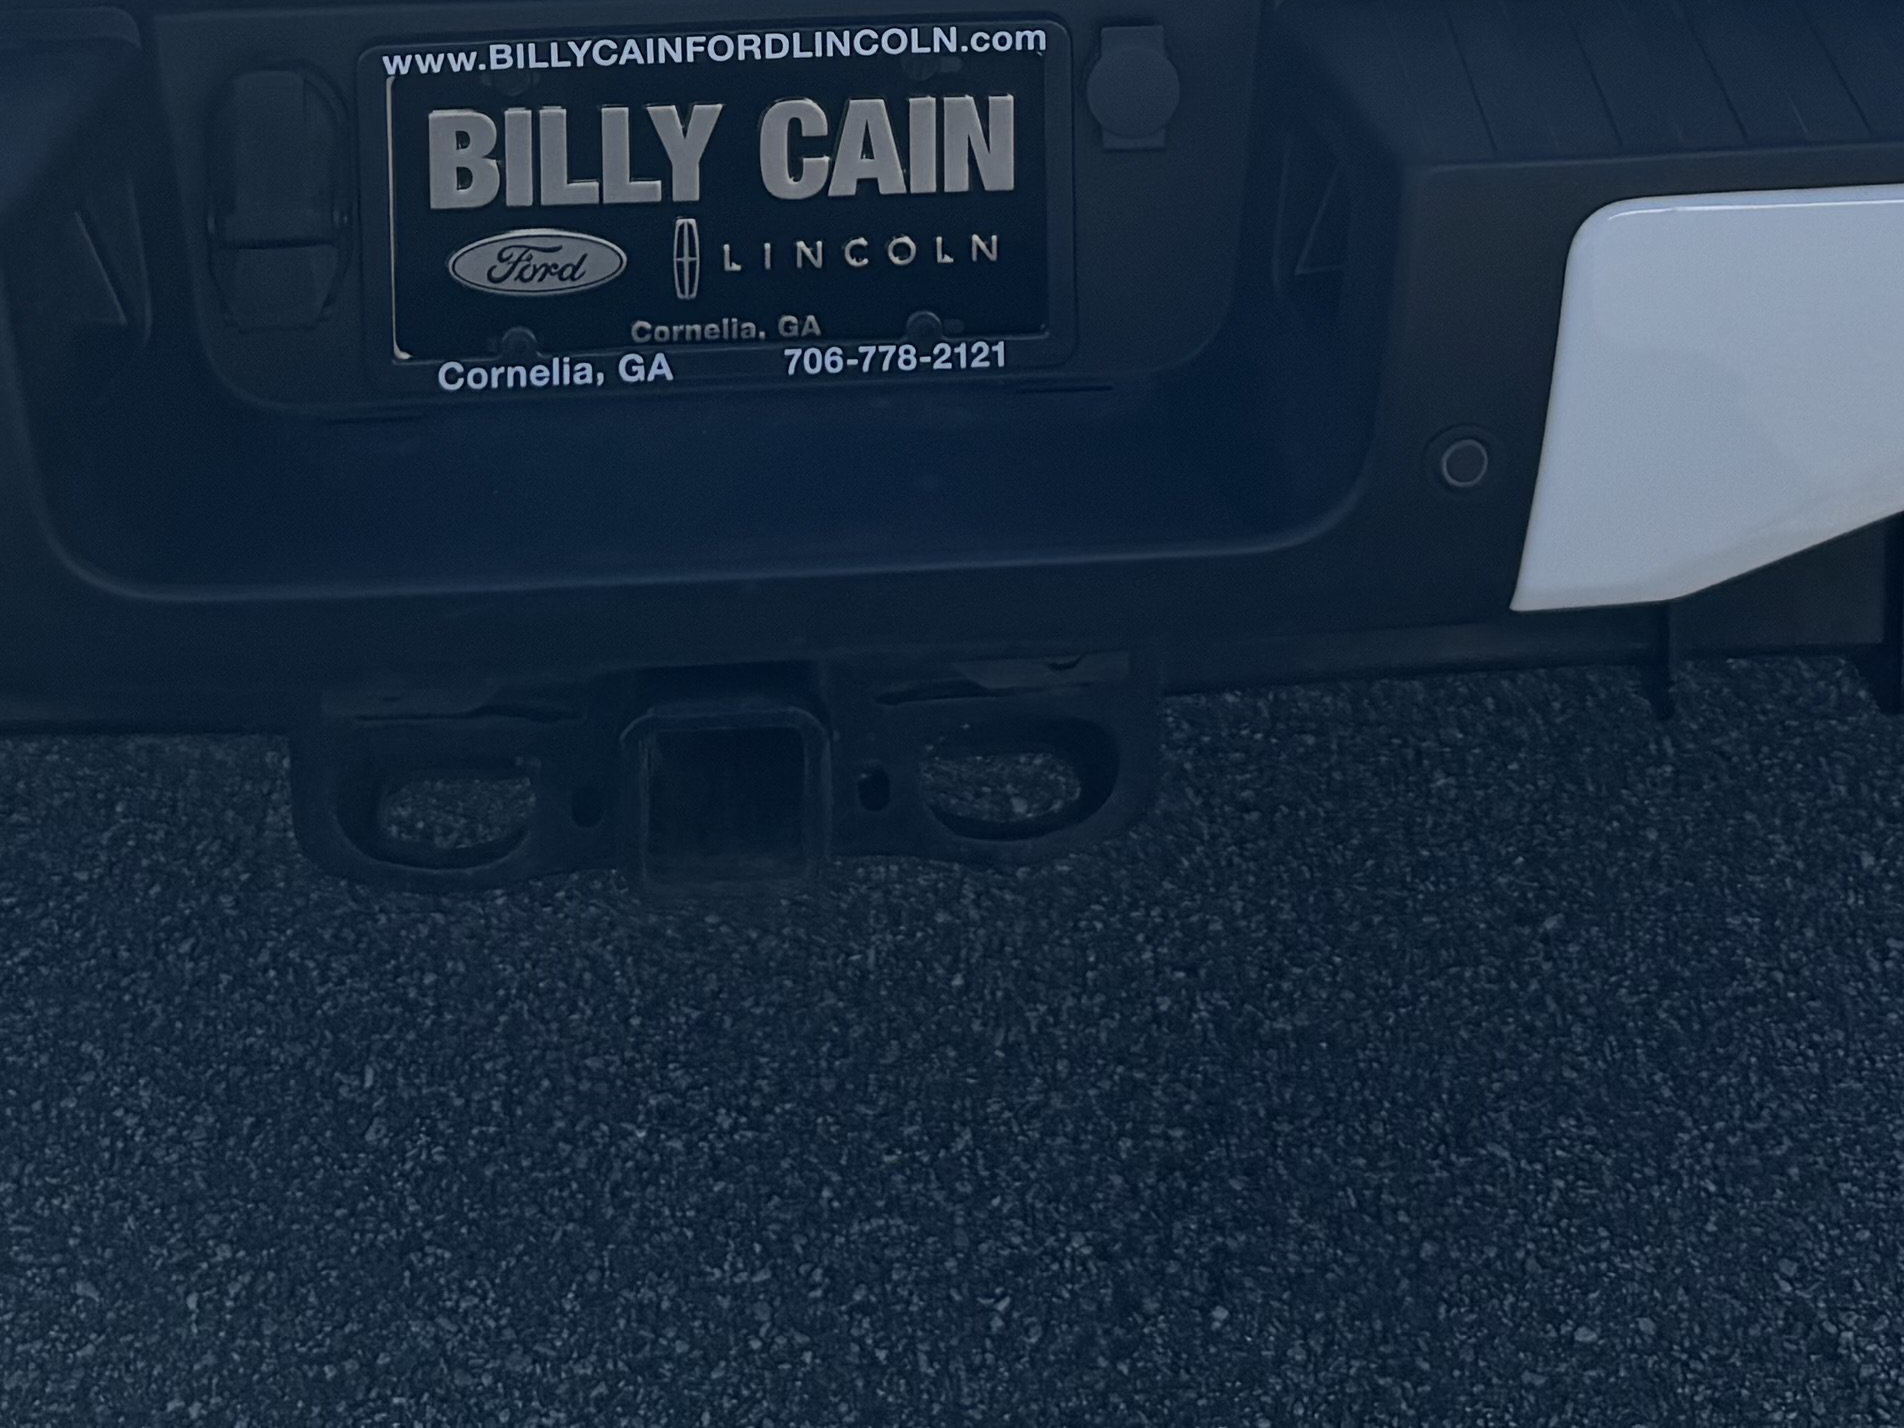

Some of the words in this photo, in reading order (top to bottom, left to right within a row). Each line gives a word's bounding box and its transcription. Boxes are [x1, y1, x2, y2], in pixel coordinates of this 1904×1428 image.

[382, 26, 1046, 76] www.BILLYCAINFORDLINCOLN.com
[428, 104, 723, 210] BILLY
[759, 95, 1015, 200] CAIN
[486, 245, 588, 284] Ford
[723, 234, 998, 272] LINCOLN
[778, 315, 822, 337] GA
[438, 357, 605, 390] Cornelia,
[618, 352, 674, 382] GA
[784, 341, 1005, 376] 706-778-2121
